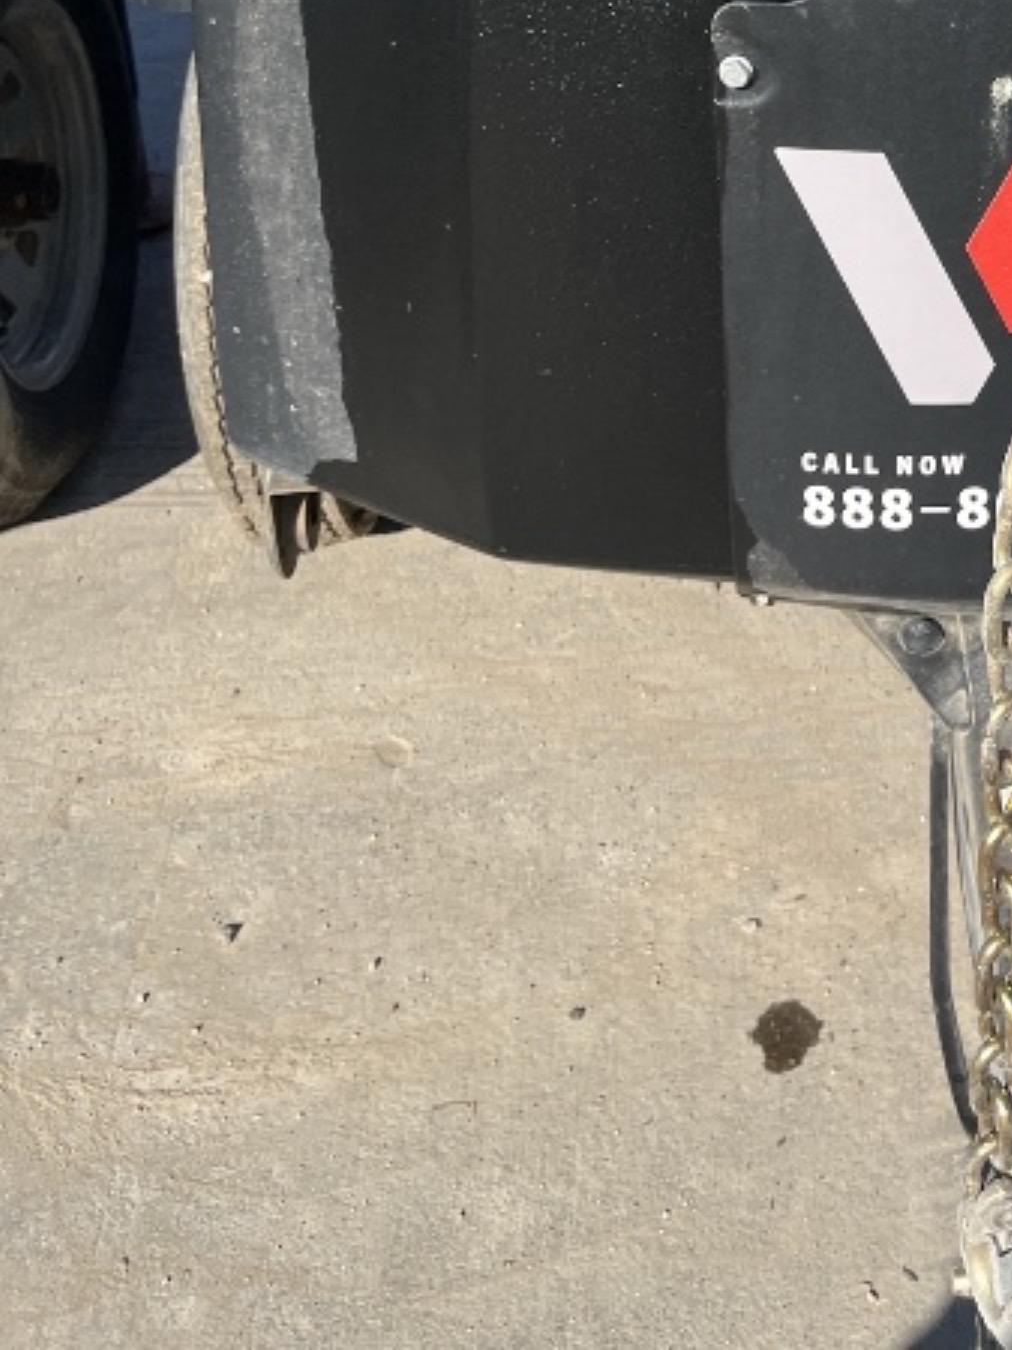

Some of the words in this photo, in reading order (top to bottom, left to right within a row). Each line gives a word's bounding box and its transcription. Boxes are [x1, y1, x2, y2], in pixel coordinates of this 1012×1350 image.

[801, 452, 880, 475] CALL
[896, 454, 966, 476] NOW
[802, 484, 999, 531] 888-8
